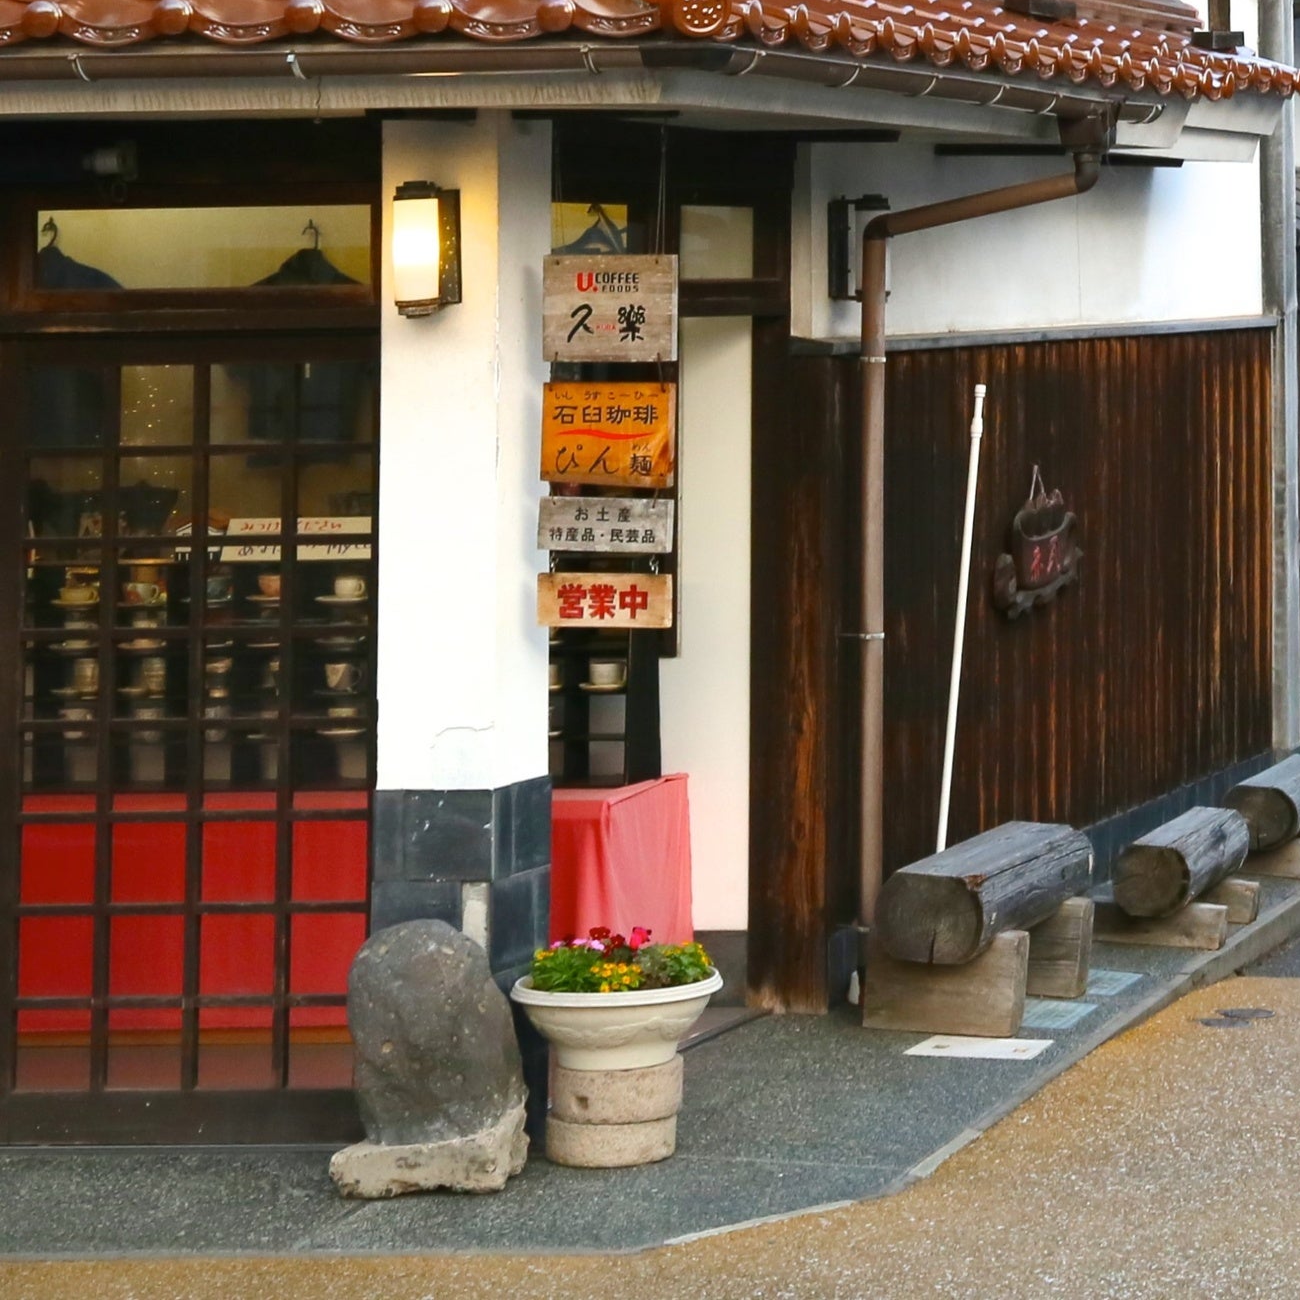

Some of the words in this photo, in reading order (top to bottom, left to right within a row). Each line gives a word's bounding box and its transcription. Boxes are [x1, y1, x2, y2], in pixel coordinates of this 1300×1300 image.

[595, 271, 640, 284] COFFEE
[602, 284, 639, 293] FOODS
[553, 404, 659, 425] 石臼珈琲
[574, 507, 632, 523] お土産
[549, 527, 656, 544] 特産品・民芸品
[557, 583, 649, 620] 営業中
